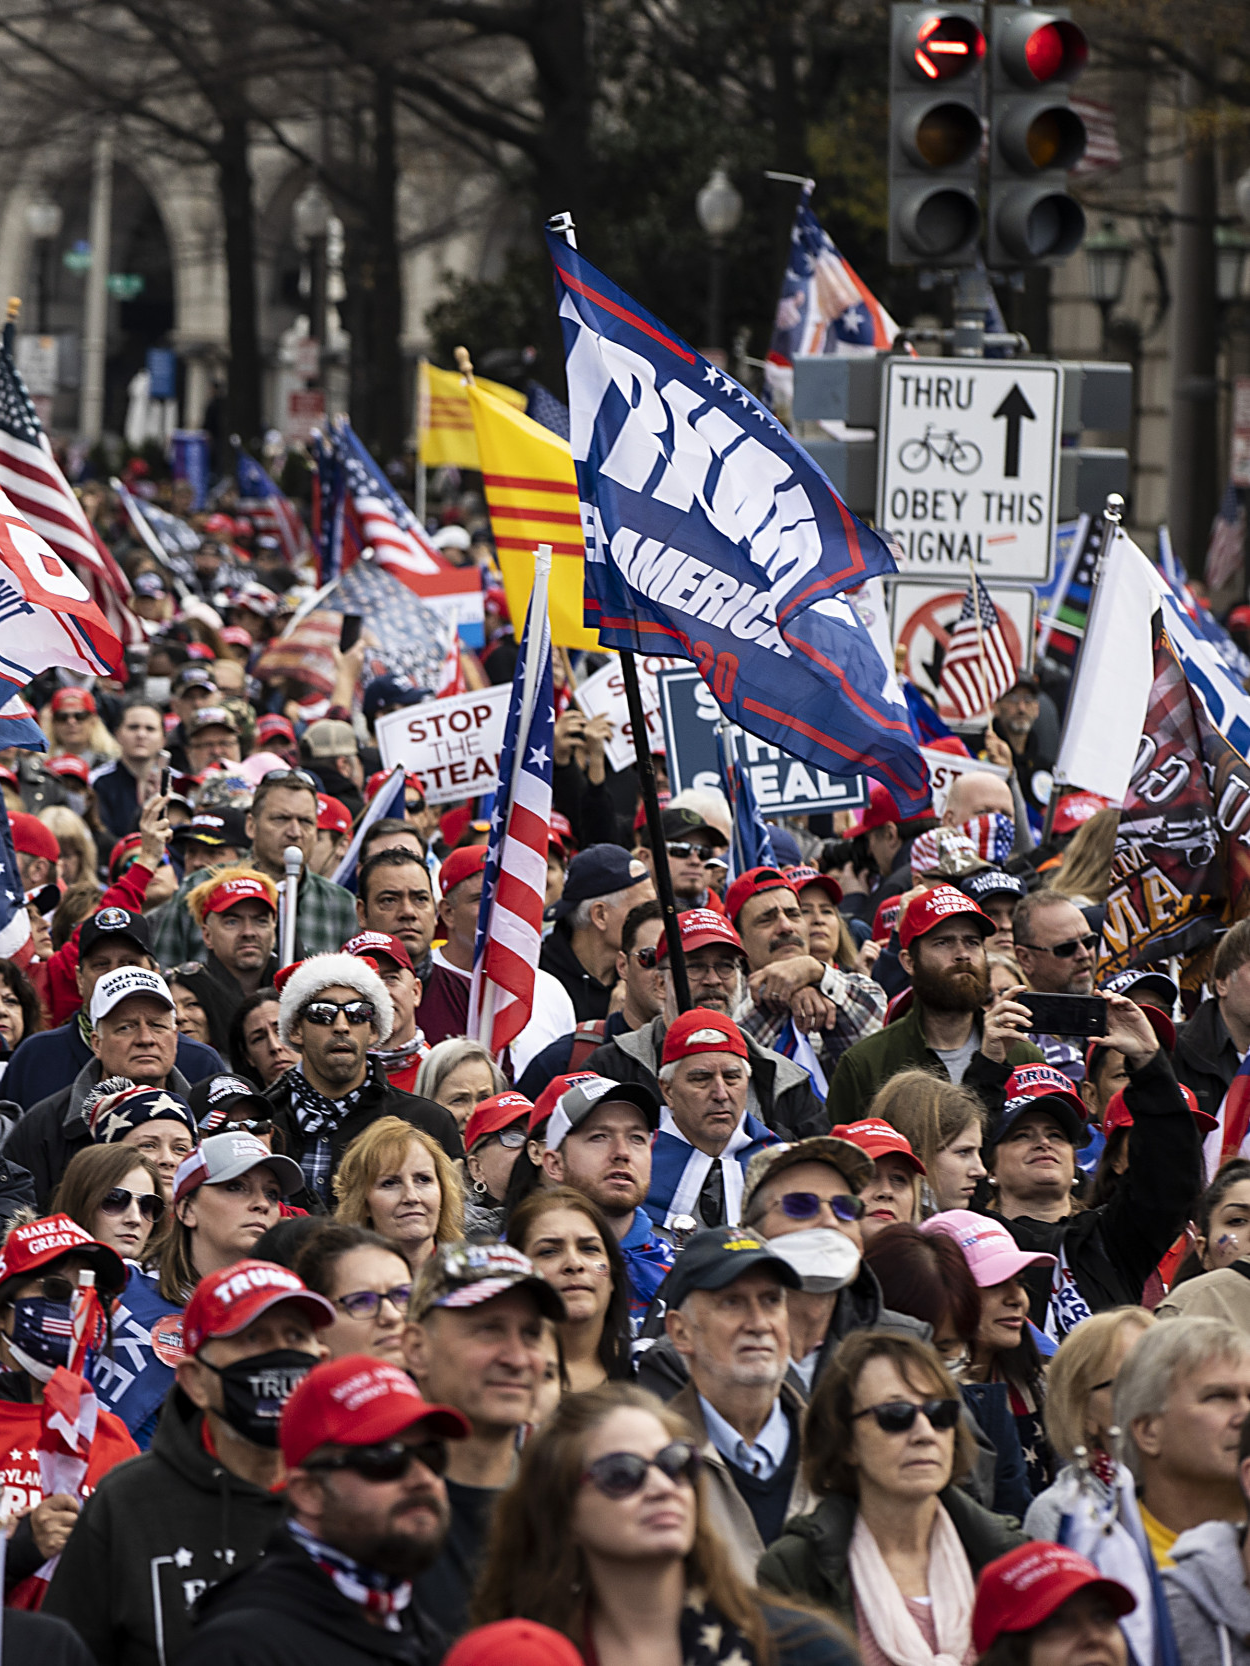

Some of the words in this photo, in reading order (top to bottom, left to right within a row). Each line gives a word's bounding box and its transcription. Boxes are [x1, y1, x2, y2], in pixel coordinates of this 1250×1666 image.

[899, 375, 974, 410] THRU
[891, 489, 973, 521] OBEY
[981, 490, 1044, 525] THIS
[895, 530, 992, 566] SIGNAL
[610, 526, 793, 659] AMERICA
[407, 704, 493, 743] STOP
[427, 731, 482, 766] THE
[414, 761, 500, 793] STEA
[693, 762, 847, 803] SEAL
[16, 1222, 54, 1242] MAKE
[28, 1235, 71, 1255] GREAT
